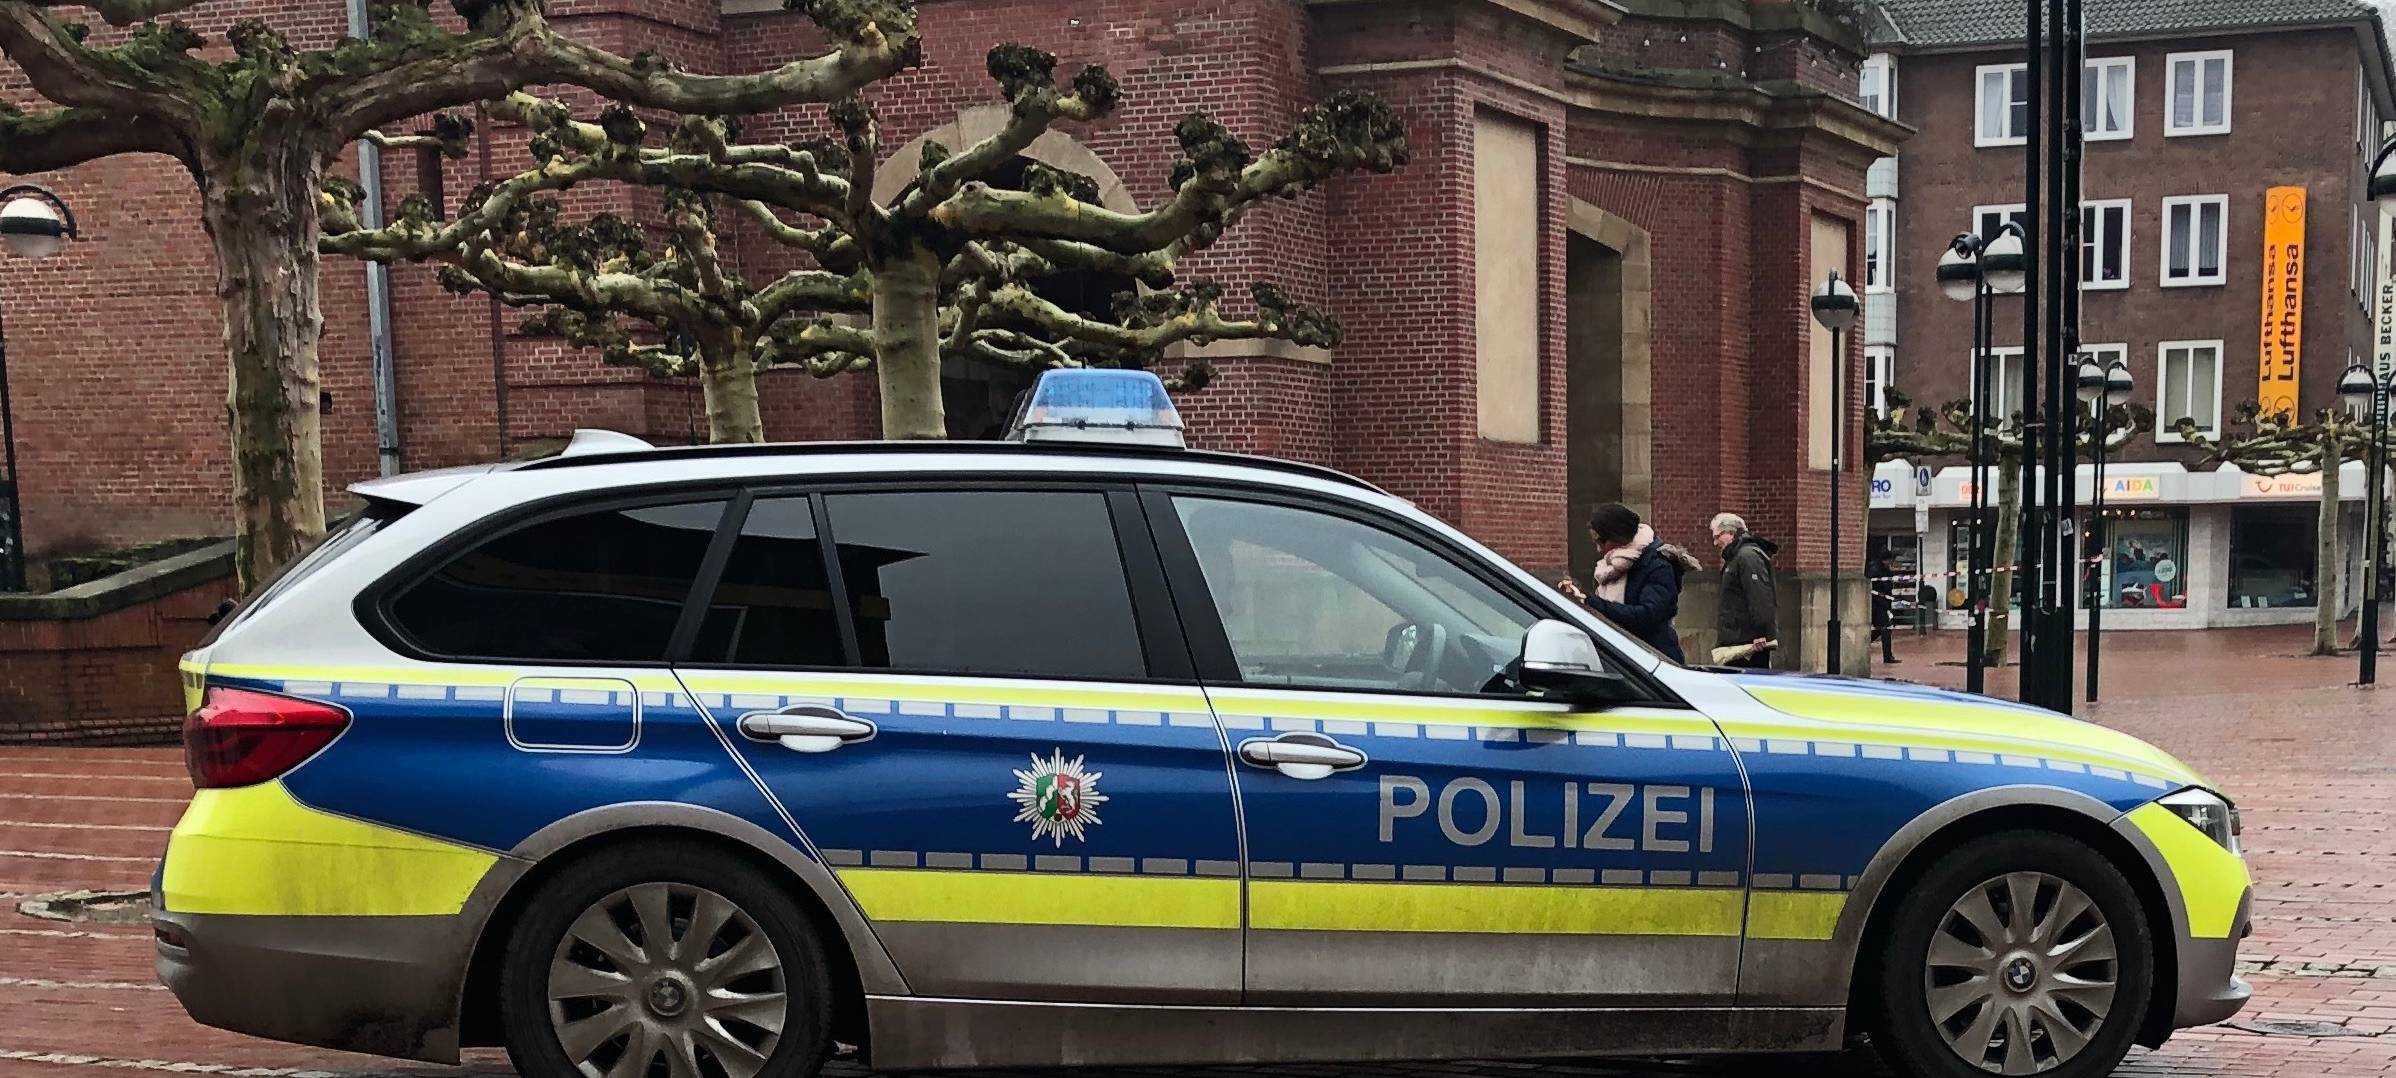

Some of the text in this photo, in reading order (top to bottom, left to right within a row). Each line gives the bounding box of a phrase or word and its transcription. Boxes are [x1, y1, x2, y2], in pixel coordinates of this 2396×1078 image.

[2262, 244, 2276, 382] Lufthansa
[2277, 243, 2299, 382] Lufthansa
[2380, 284, 2394, 345] BECKER
[1871, 479, 1891, 493] RO
[2114, 479, 2153, 492] AIDA
[2278, 483, 2321, 493] TUI Cruise
[1379, 774, 1714, 853] POLIZEI
